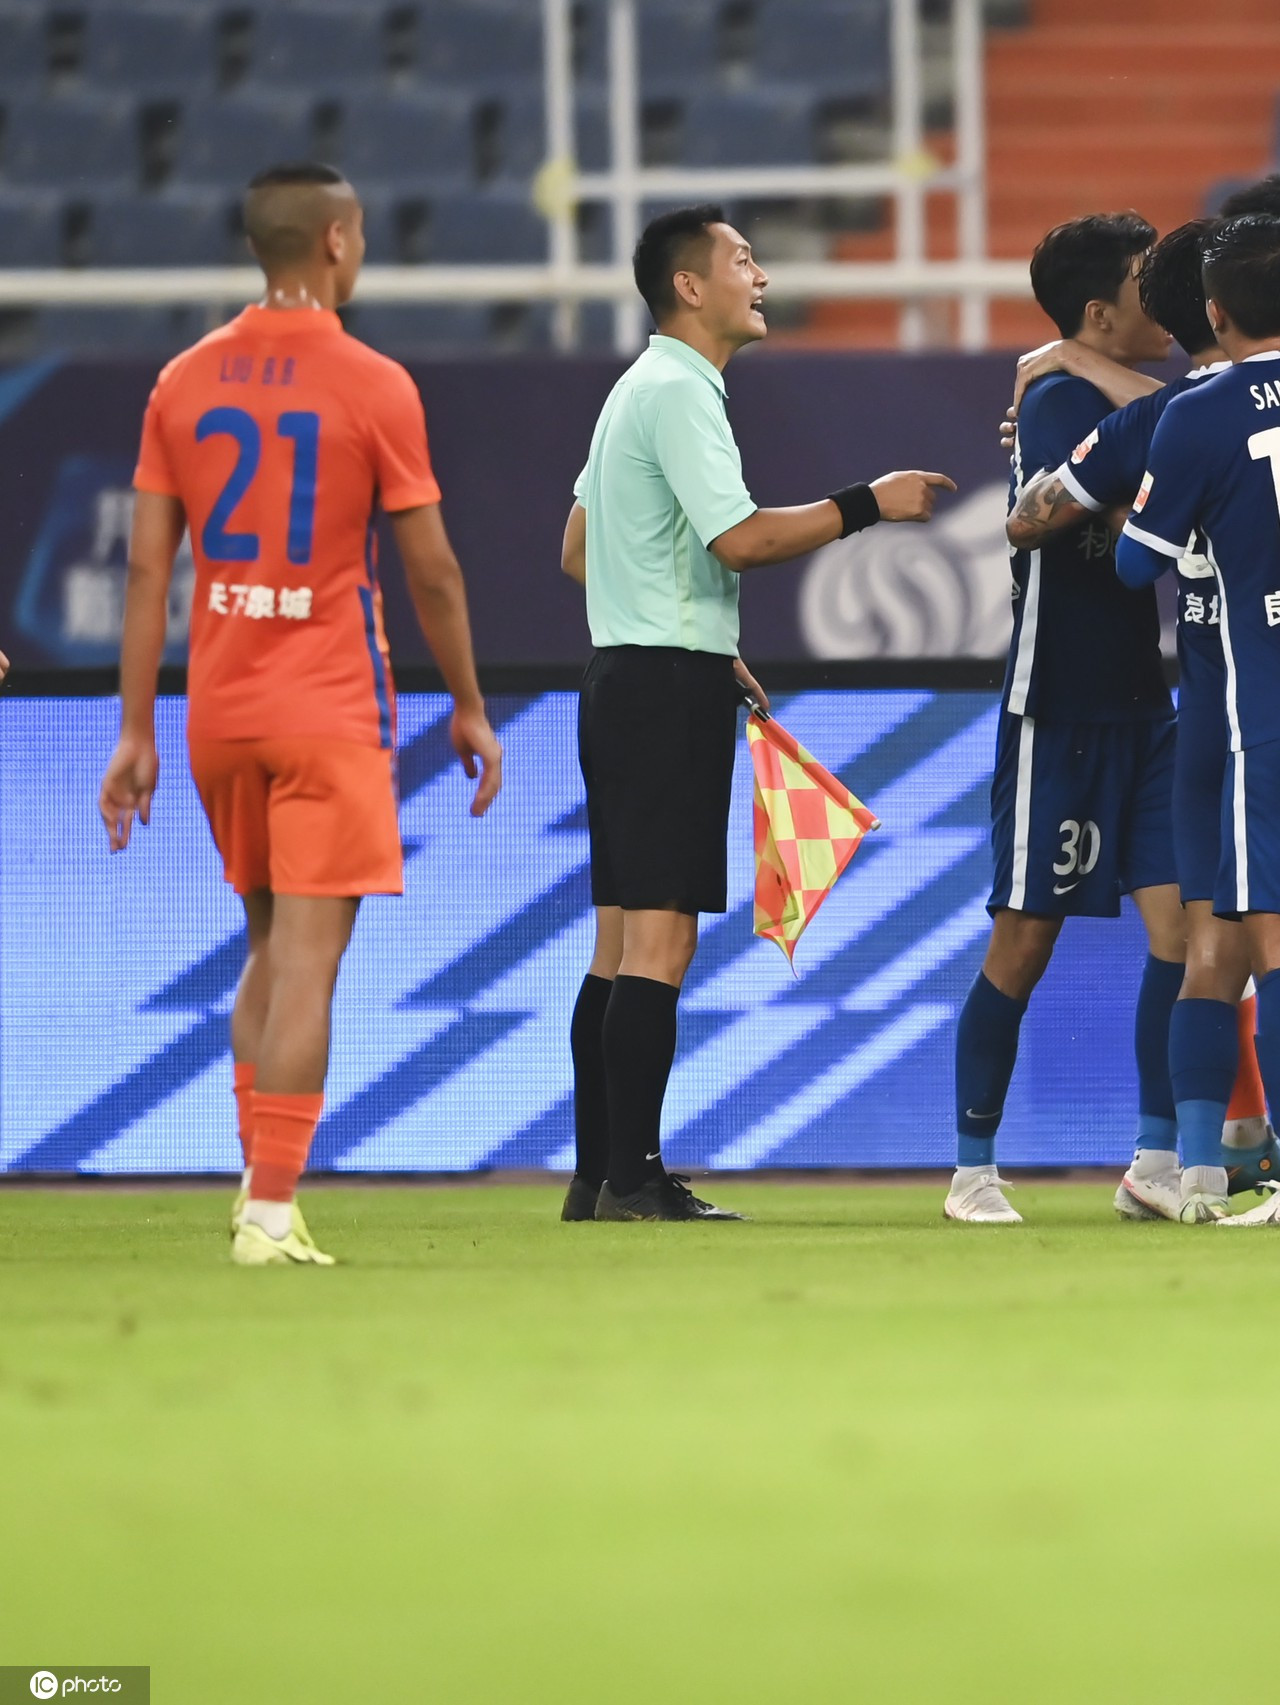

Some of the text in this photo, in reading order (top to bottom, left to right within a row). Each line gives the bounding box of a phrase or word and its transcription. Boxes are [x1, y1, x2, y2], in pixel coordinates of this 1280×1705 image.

[219, 356, 252, 383] LIU
[194, 406, 321, 565] 21
[208, 582, 313, 620] 天下泉城
[1053, 819, 1101, 876] 30
